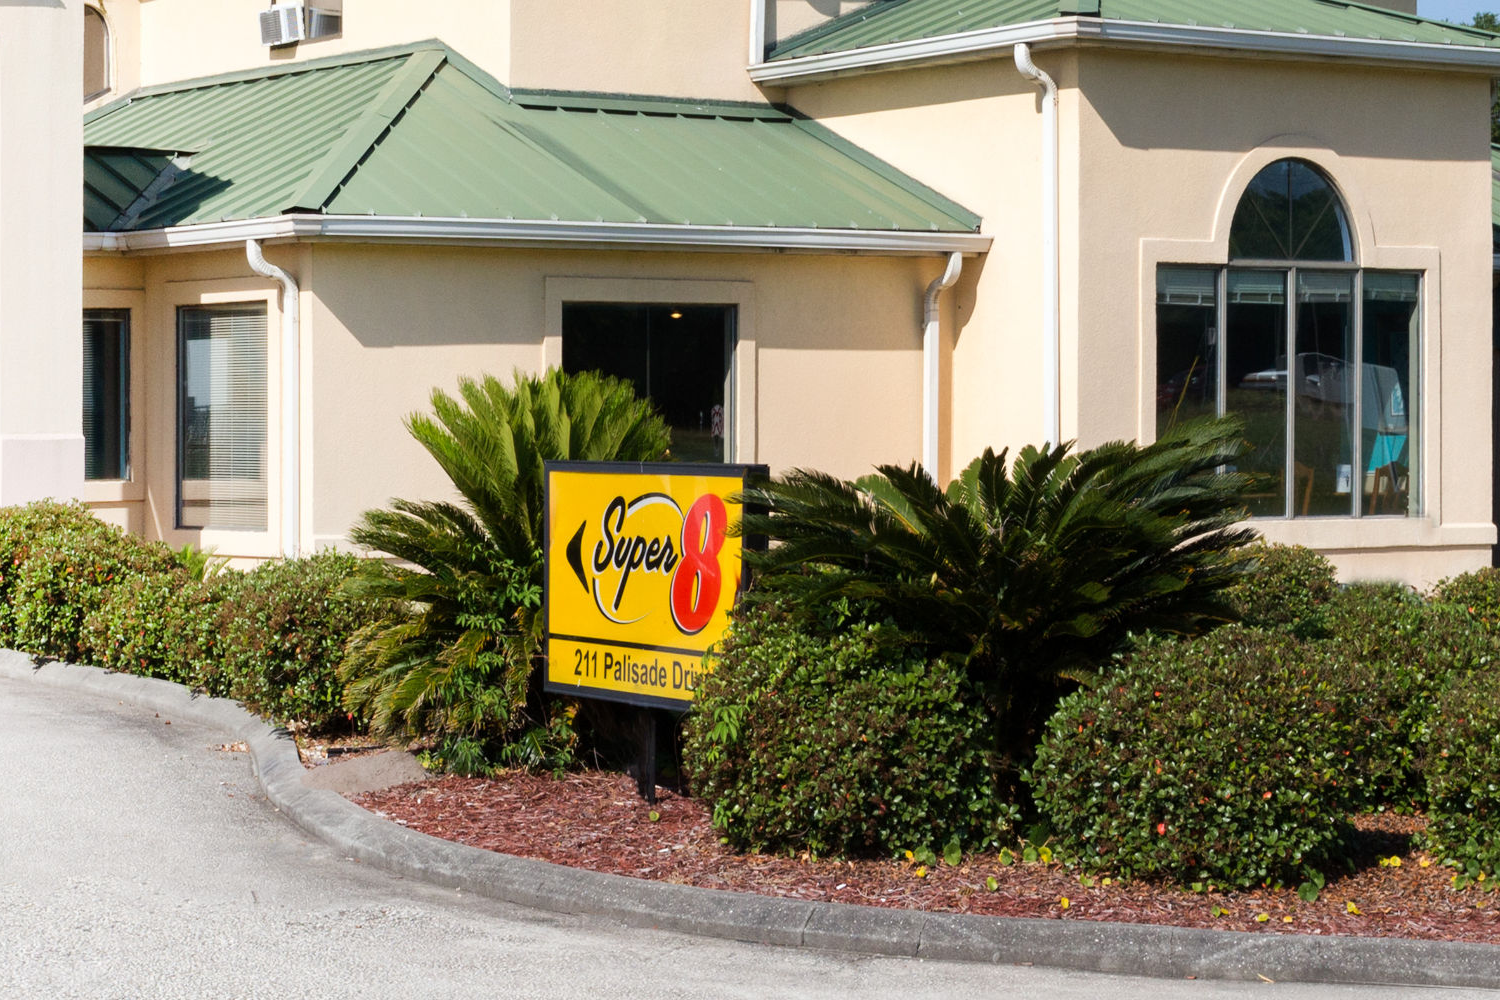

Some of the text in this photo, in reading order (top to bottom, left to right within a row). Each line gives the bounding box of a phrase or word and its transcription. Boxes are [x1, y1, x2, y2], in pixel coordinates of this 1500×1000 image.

[592, 494, 728, 635] Super 8
[574, 648, 702, 692] 211 Palisade Dri
